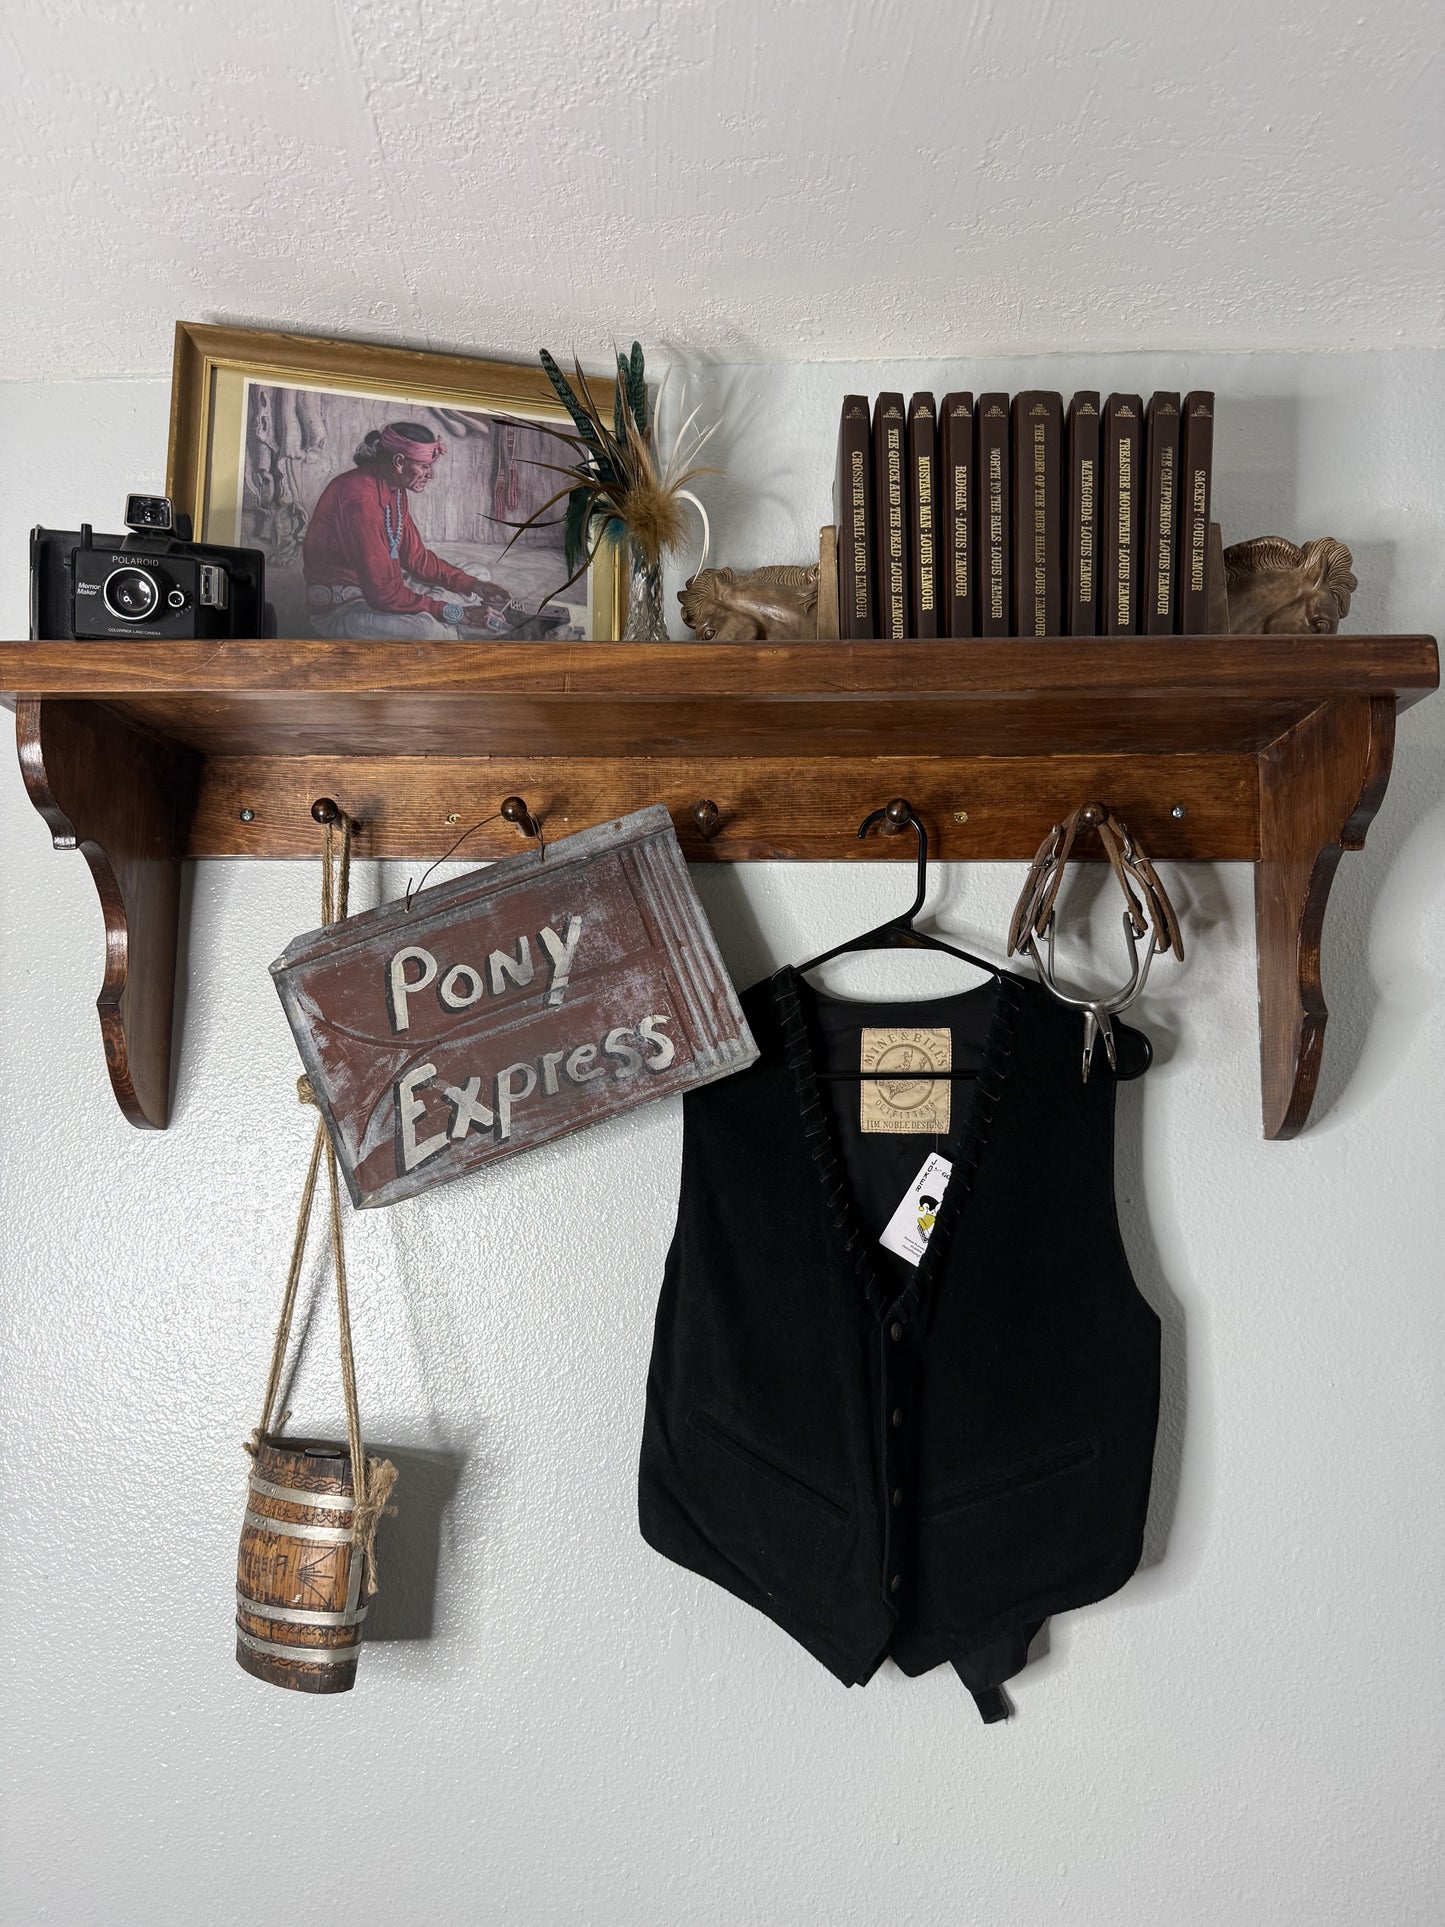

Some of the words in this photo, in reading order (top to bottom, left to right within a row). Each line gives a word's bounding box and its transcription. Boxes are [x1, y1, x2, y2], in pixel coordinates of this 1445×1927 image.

[888, 428, 900, 449] THE
[1034, 424, 1045, 442] THE
[888, 450, 900, 482] QUICK
[990, 448, 1001, 479] NORTH
[1034, 444, 1046, 473] RIDER
[1119, 438, 1130, 488] TREASURE
[1160, 446, 1173, 467] THE
[852, 451, 864, 506] CROSSFIRE
[889, 483, 901, 505] AND
[918, 456, 931, 503] MUSTANG
[955, 465, 967, 510] RADIGAN
[990, 481, 1002, 493] TO
[1034, 474, 1046, 488] OF
[1081, 460, 1093, 522] MATAGORDA
[1194, 470, 1206, 514] SACKETT
[991, 494, 1002, 513] THE
[1034, 489, 1046, 508] THE
[1159, 468, 1172, 535] CALIFORNIOS
[853, 508, 866, 538] TRAIL
[889, 507, 901, 527] THE
[920, 505, 932, 528] MAN
[991, 514, 1002, 542] RAILS
[1034, 509, 1046, 534] RUBY
[1118, 490, 1130, 544] MOUNTAIN
[1193, 517, 1205, 546] LOUIS
[890, 529, 902, 557] DEAD
[955, 517, 967, 548] LOUIS
[1080, 525, 1092, 556] LOUIS
[112, 555, 159, 567] POLAROID
[854, 542, 866, 572] LOUIS
[920, 534, 932, 564] LOUIS
[991, 546, 1002, 575] LOUIS
[1034, 535, 1046, 563] HILLS
[1118, 548, 1130, 579] LOUIS
[1158, 538, 1171, 570] LOUIS
[890, 562, 903, 593] LOUIS
[955, 551, 967, 597] L'AMOUR
[1034, 567, 1046, 595] LOUIS
[1080, 558, 1092, 602] L'AMOUR
[1192, 548, 1204, 591] L'AMOUR
[78, 582, 103, 591] Memor
[855, 575, 868, 618] L'AMOUR
[921, 566, 934, 610] L'AMOUR
[991, 577, 1002, 618] L'AMOUR
[1157, 571, 1170, 615] L'AMOUR
[892, 595, 904, 639] L'AMOUR
[1034, 597, 1046, 636] L'AMOUR
[1118, 581, 1130, 625] L'AMOUR
[864, 1033, 897, 1065] MINE
[901, 1032, 910, 1041] &
[875, 1099, 936, 1119] OUTFITTERS
[866, 1120, 880, 1130] JIM
[883, 1120, 910, 1130] NOBLE
[911, 1121, 944, 1130] DESIGNS
[915, 1159, 938, 1192] JOKER
